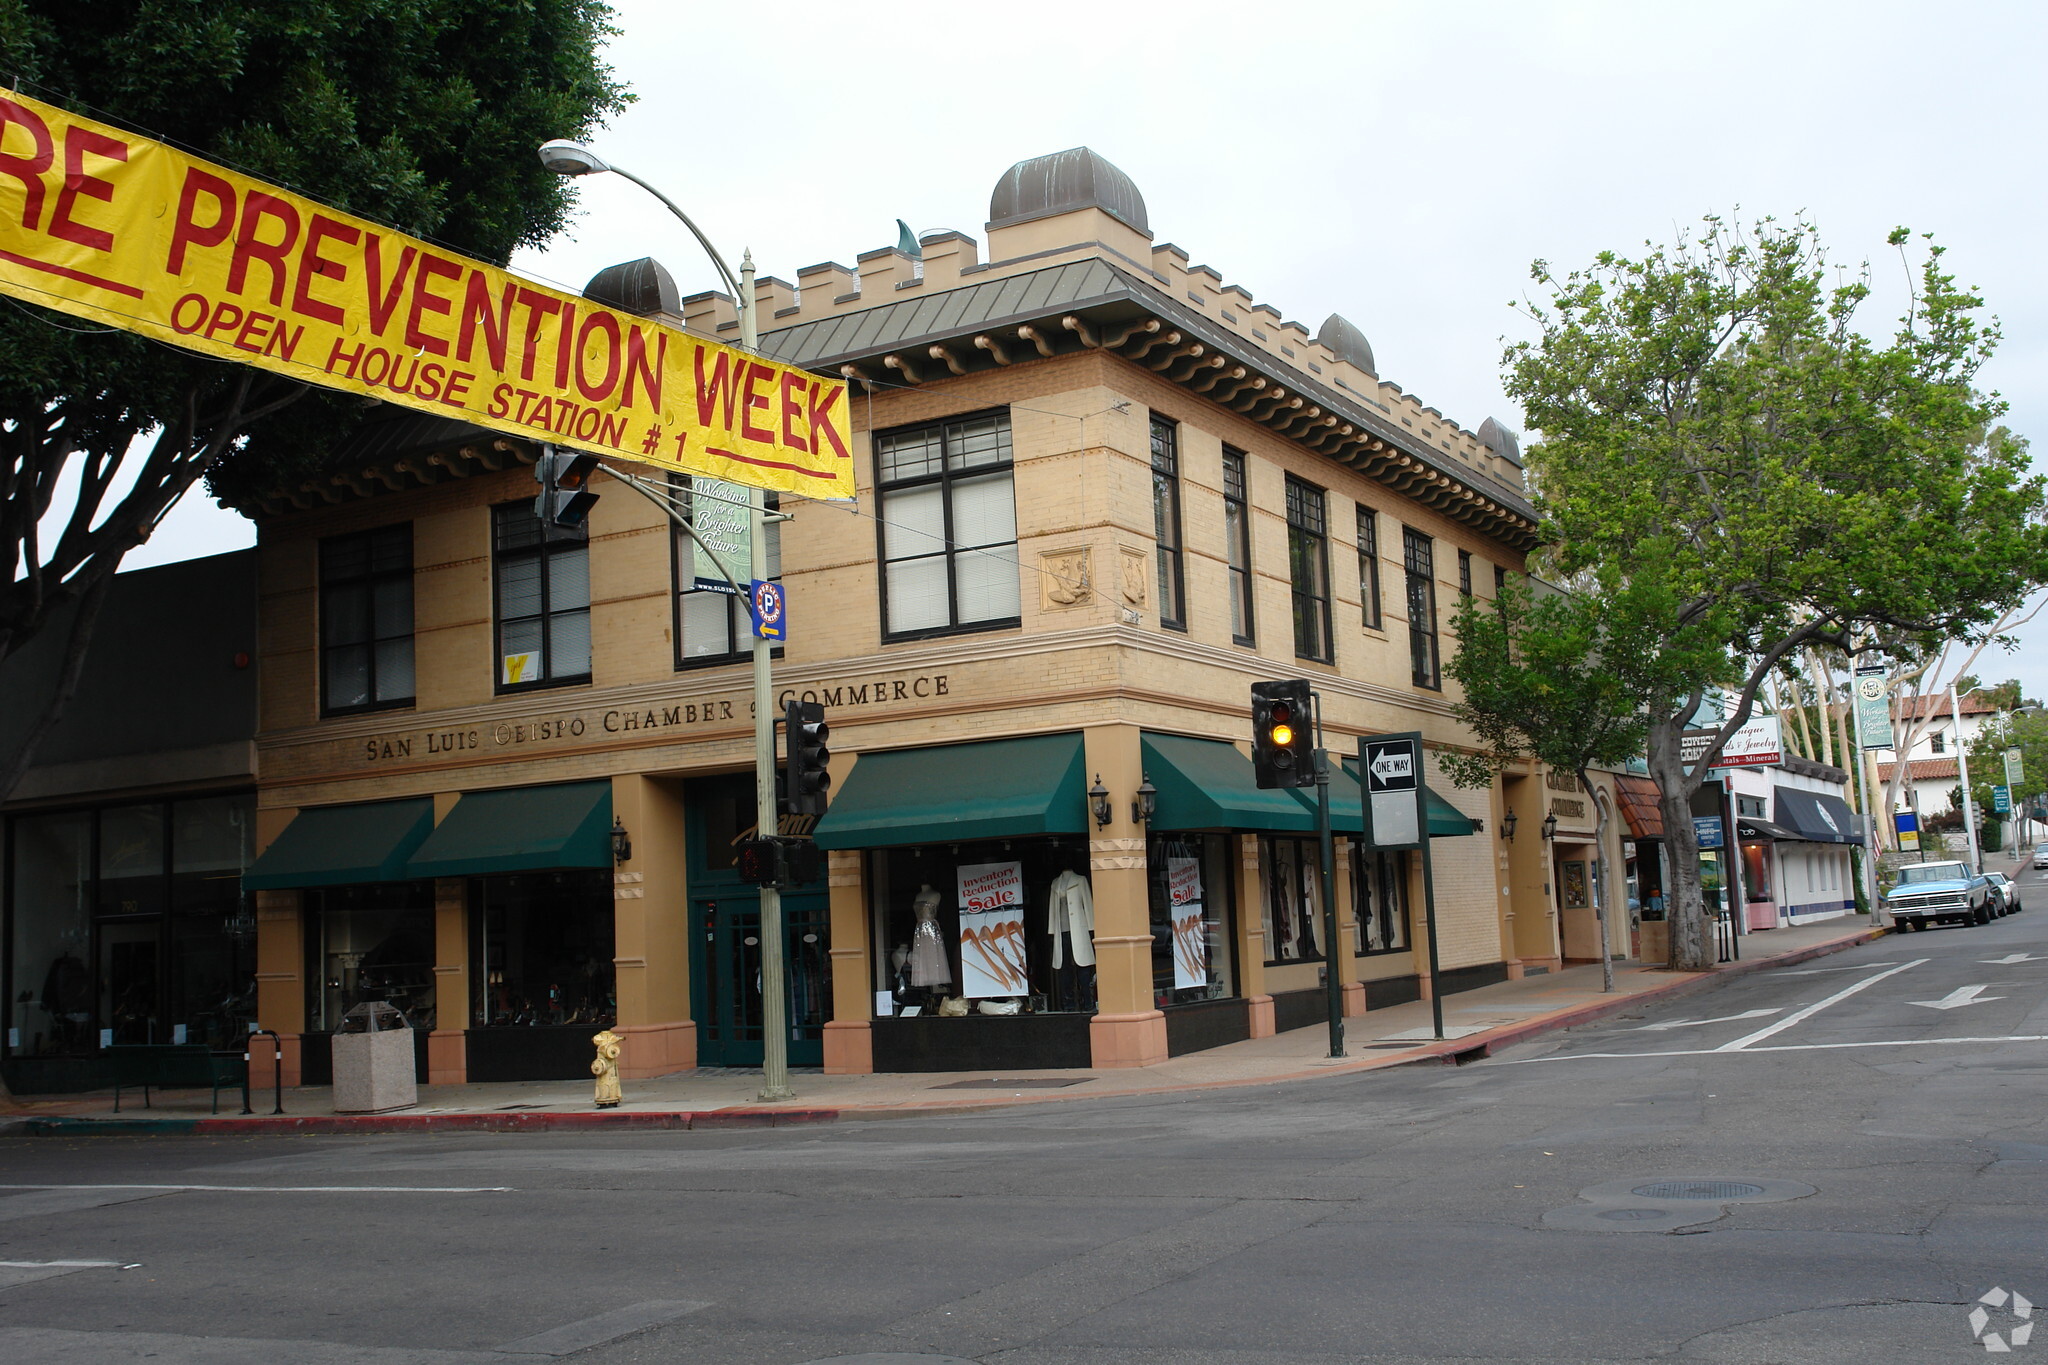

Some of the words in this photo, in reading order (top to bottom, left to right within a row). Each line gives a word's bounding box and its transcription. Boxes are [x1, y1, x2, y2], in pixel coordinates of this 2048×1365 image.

[166, 166, 668, 415] PREVENTION
[694, 345, 850, 458] WEEK
[170, 293, 304, 362] OPEN
[324, 337, 476, 408] HOUSE
[488, 383, 628, 448] STATION
[695, 479, 747, 508] Working
[713, 503, 727, 515] for
[696, 510, 747, 536] Brighter
[698, 532, 739, 553] Future
[764, 593, 774, 612] P
[367, 739, 411, 760] SAN
[427, 731, 478, 753] LUIS
[494, 718, 585, 745] OBISPO
[603, 701, 734, 732] CHAMBER
[779, 675, 949, 711] COMMERCE
[1737, 727, 1764, 737] nique
[1743, 737, 1776, 753] Jewelry
[1375, 760, 1391, 773] ONE
[1393, 758, 1409, 772] WAY
[963, 867, 1015, 888] Inventory
[1170, 864, 1197, 879] Inventory
[1170, 872, 1198, 889] Reduction
[962, 876, 1019, 898] Reduction
[1173, 885, 1196, 905] Sale
[967, 890, 1015, 913] Sale
